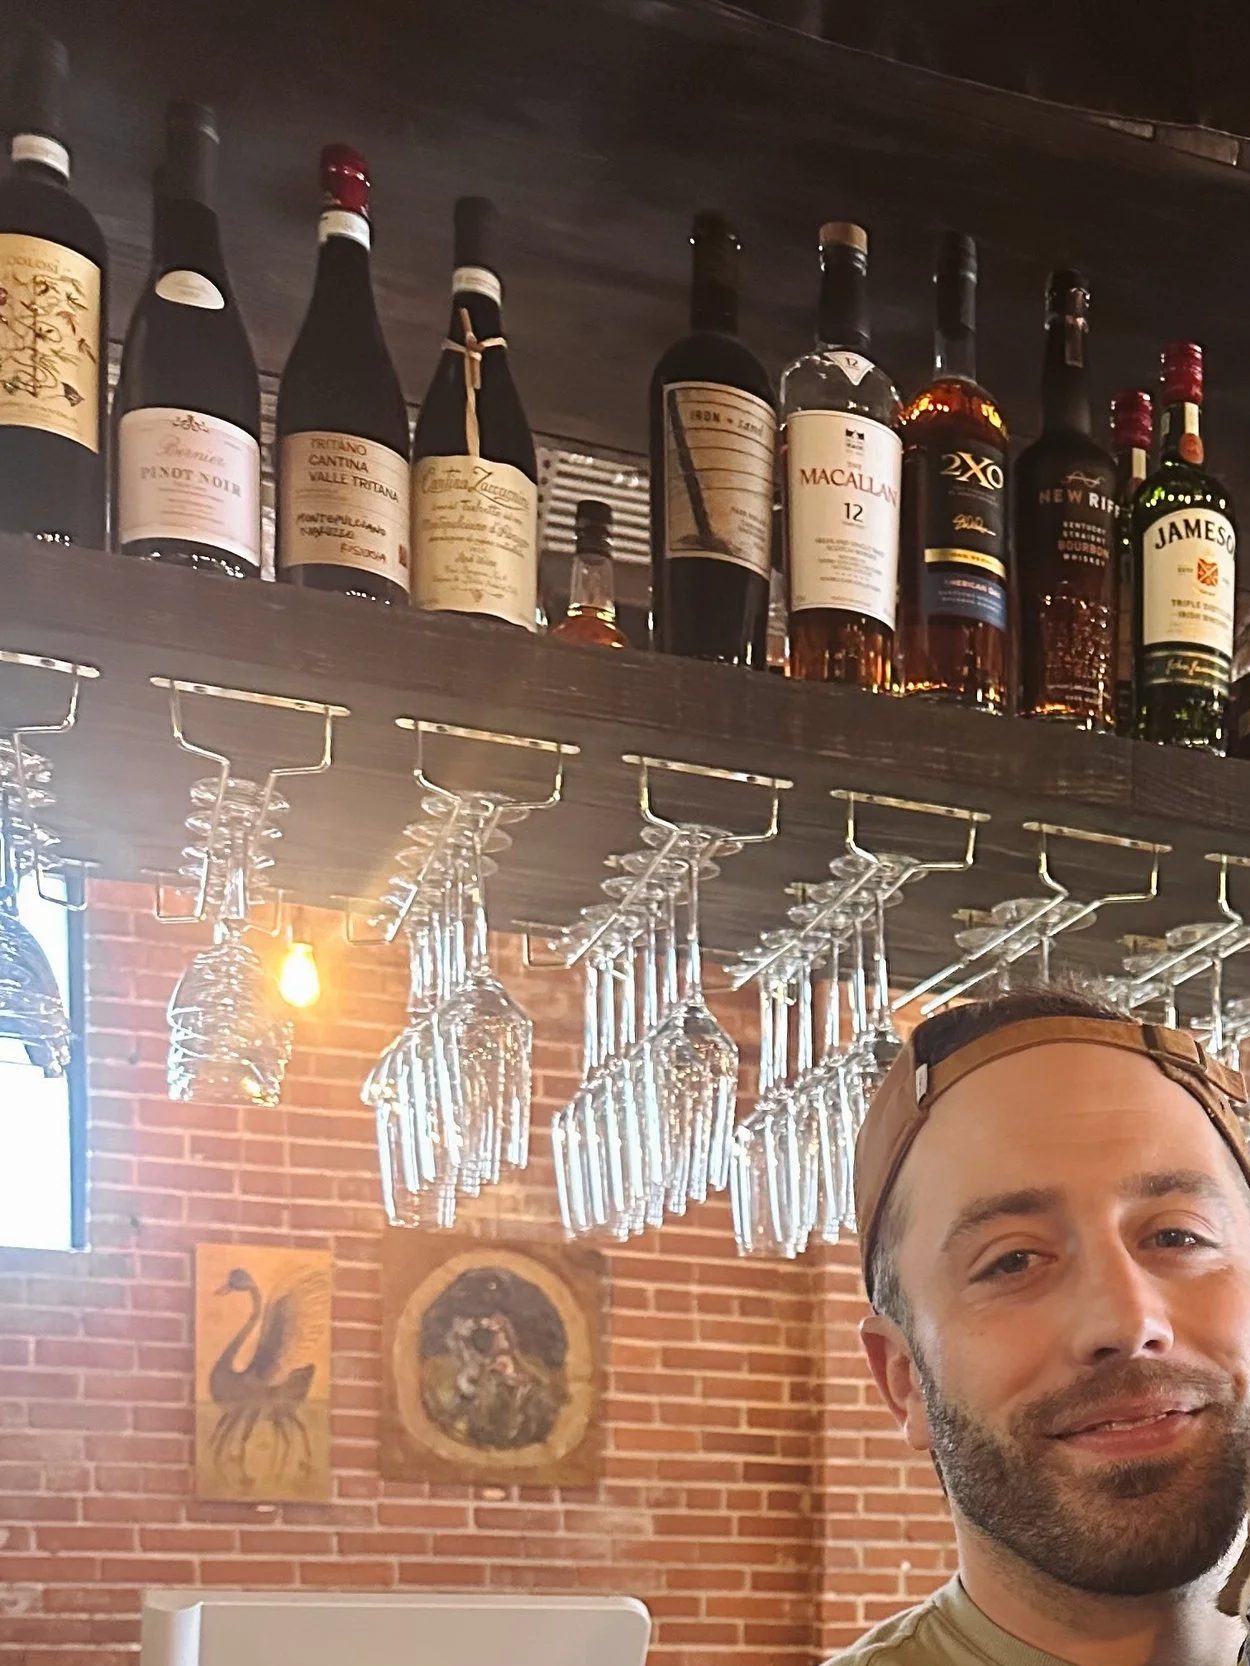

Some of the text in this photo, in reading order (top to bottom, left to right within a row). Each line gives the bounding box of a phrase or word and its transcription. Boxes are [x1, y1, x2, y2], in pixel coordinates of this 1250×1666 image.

[310, 437, 368, 456] TRITANO
[308, 453, 369, 473] CANTINA
[940, 451, 1004, 490] 2XO
[140, 465, 242, 498] PINOT NOIR
[309, 471, 348, 485] VALLE
[351, 475, 399, 502] TRITANA
[799, 468, 897, 508] MACALLAN
[843, 502, 864, 522] 12
[1038, 489, 1121, 519] NEW RIFF
[1154, 518, 1235, 556] JAMESO
